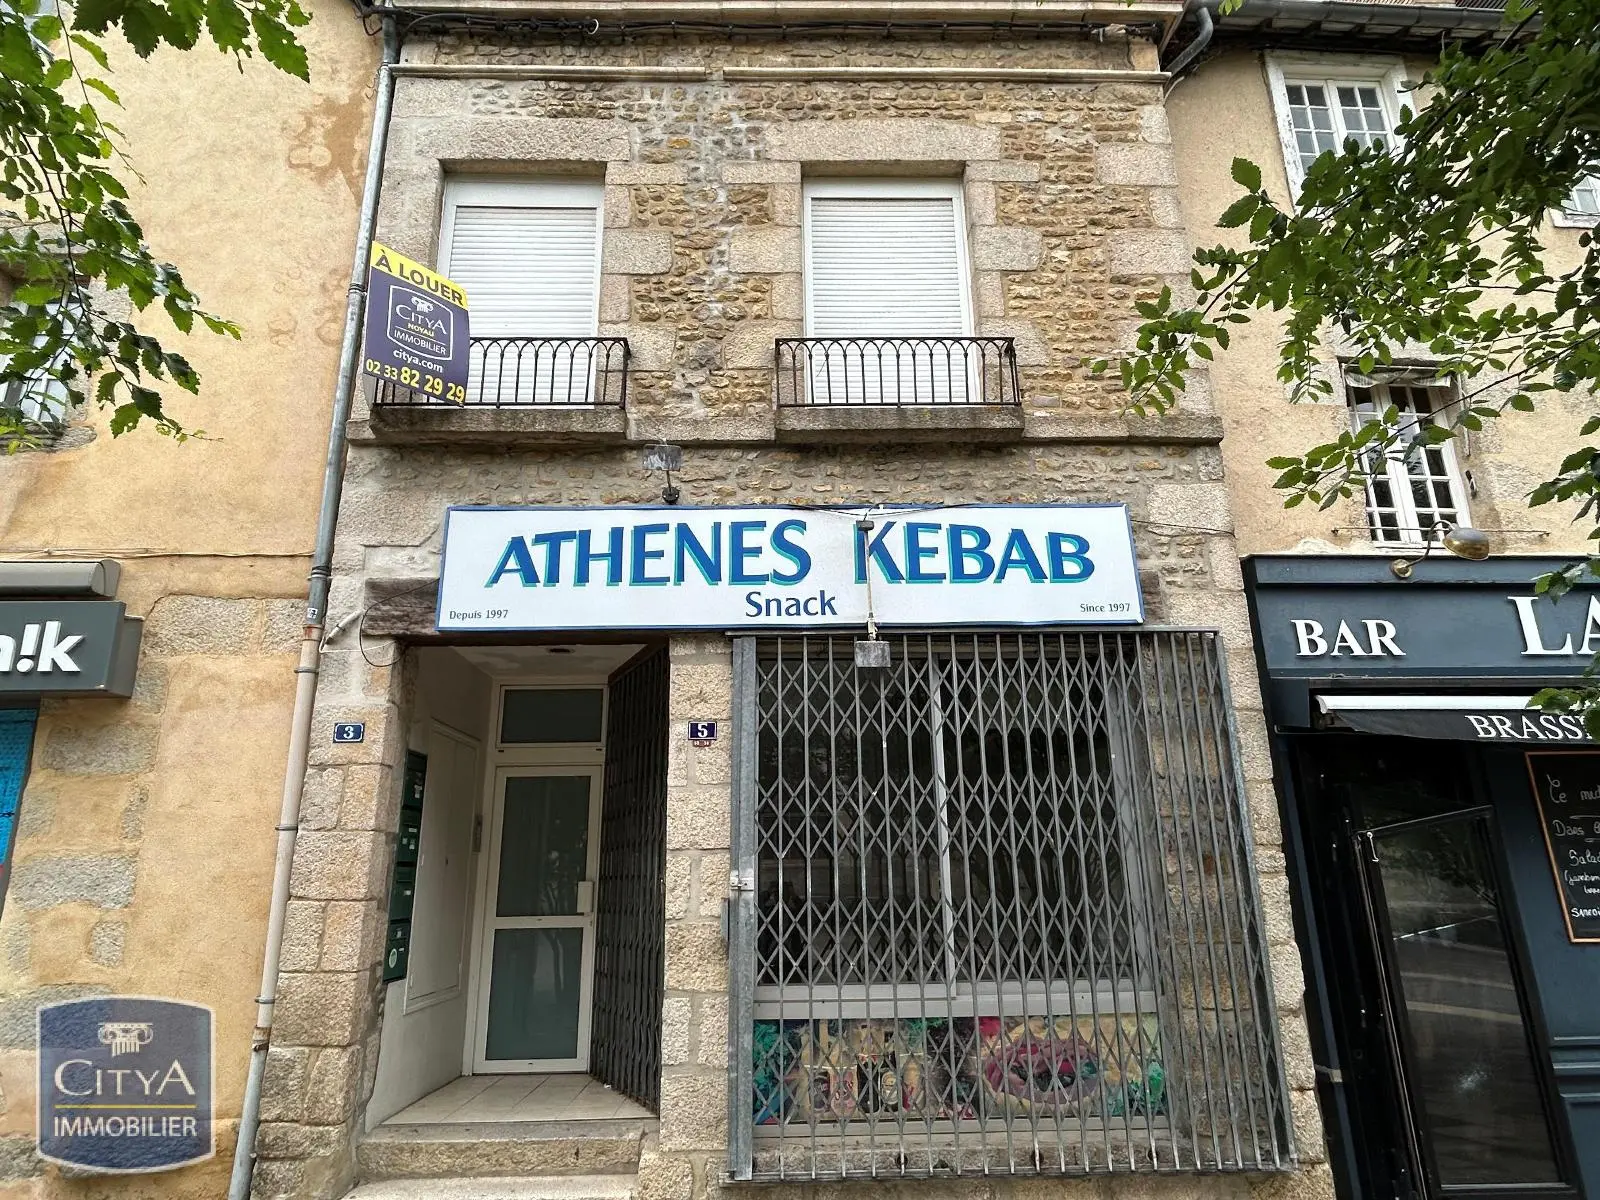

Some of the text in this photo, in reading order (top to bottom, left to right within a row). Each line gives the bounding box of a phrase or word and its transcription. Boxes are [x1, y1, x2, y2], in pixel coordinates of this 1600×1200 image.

[376, 249, 464, 307] À LOUER
[395, 304, 447, 335] CITYA
[394, 329, 447, 356] IMMOBILIER
[393, 348, 444, 374] citya.com
[365, 358, 465, 403] 02 33 82 29 29
[484, 518, 1095, 587] ATHENES KEBAB
[449, 609, 509, 621] Depuis 1997
[745, 590, 838, 617] Snack
[1080, 603, 1131, 613] Since 1997
[1290, 619, 1407, 656] BAR
[343, 725, 354, 739] 3
[697, 723, 708, 738] 5
